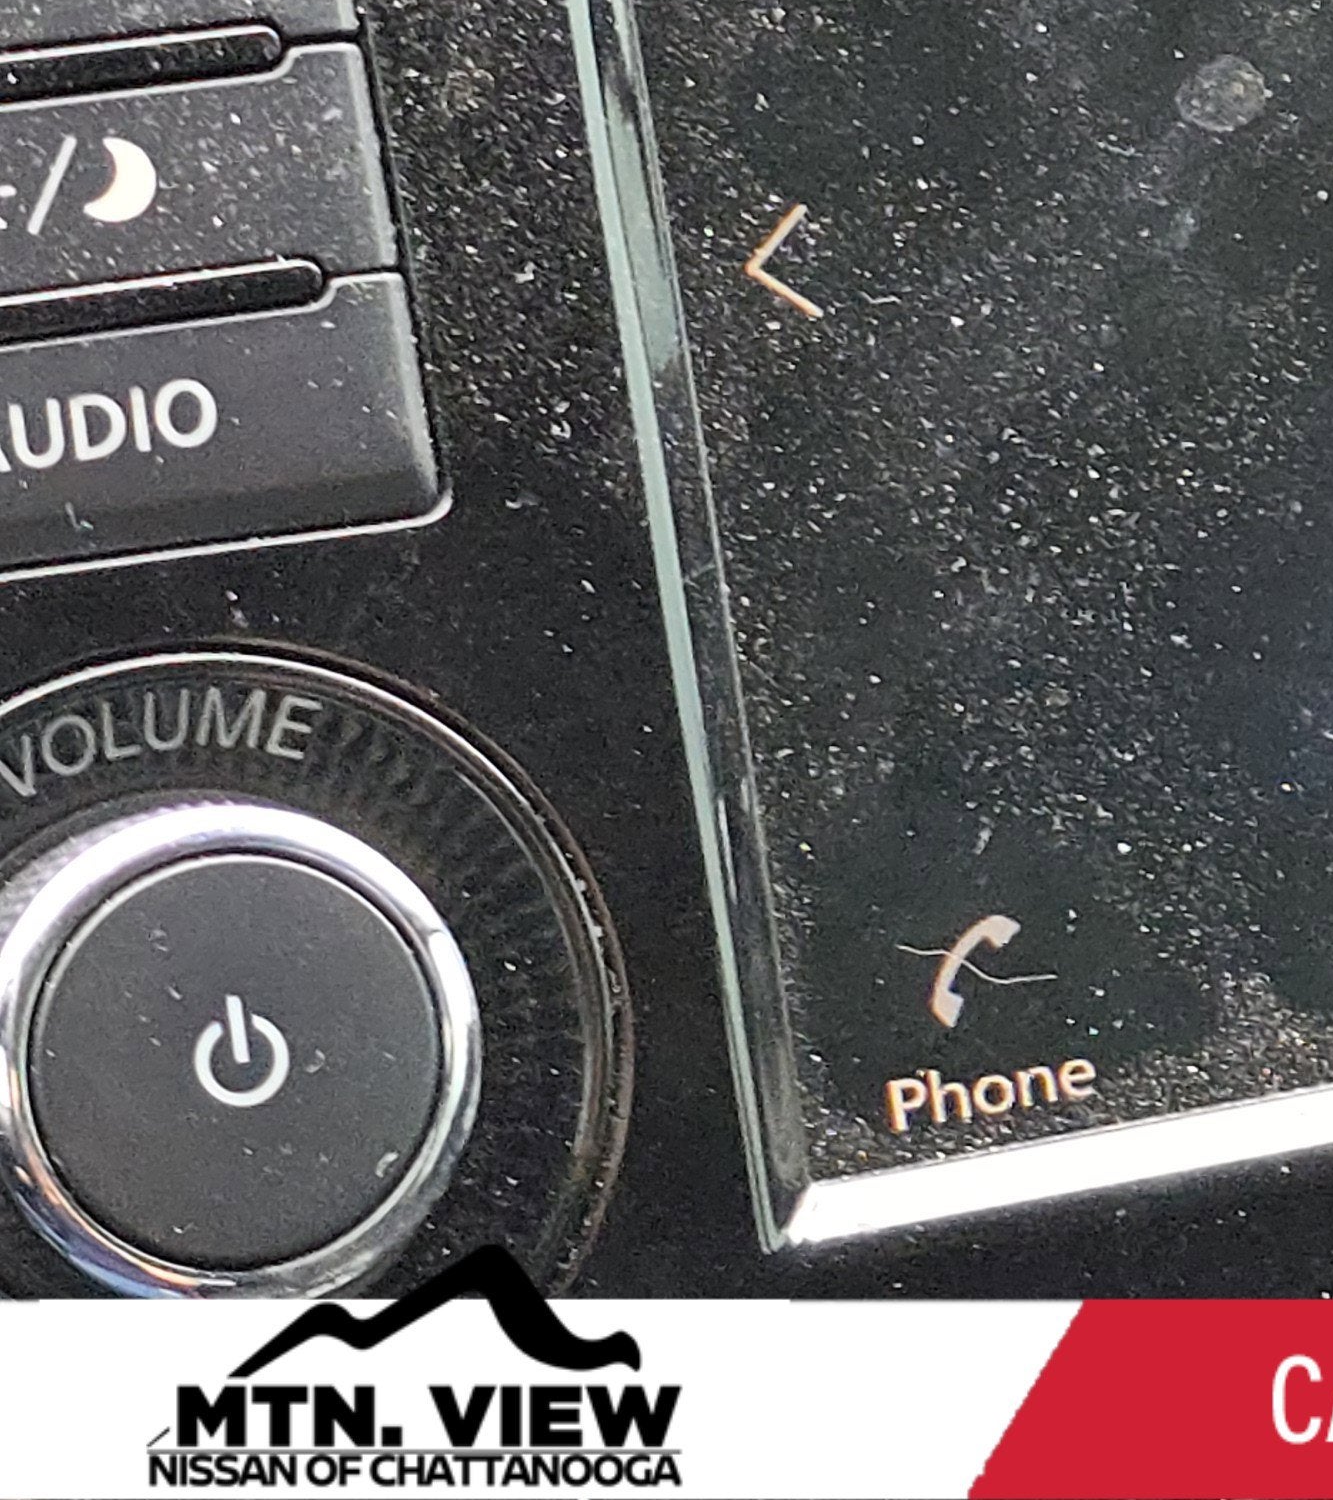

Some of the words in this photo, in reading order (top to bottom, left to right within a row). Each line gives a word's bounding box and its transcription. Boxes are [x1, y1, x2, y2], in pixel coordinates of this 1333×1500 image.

[0, 378, 218, 472] UDIO
[0, 686, 323, 798] VOLUME
[885, 1056, 1097, 1132] Phone
